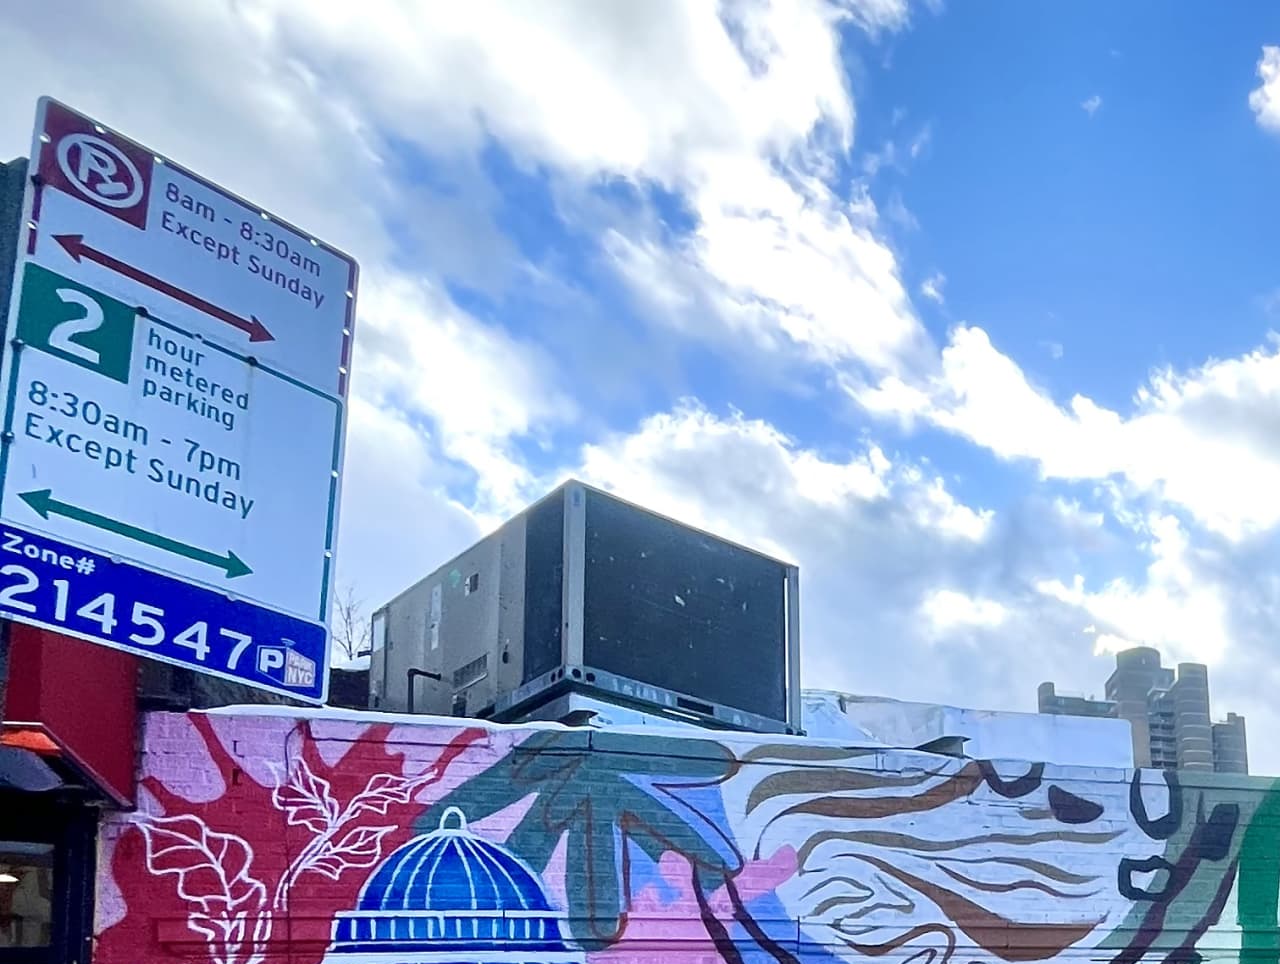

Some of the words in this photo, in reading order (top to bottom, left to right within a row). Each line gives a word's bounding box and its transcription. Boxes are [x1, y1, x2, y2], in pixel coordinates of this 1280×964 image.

[161, 211, 240, 267] Except
[247, 255, 325, 310] Sunday
[165, 182, 215, 223] 8am
[239, 220, 321, 277] 8:30am
[49, 288, 104, 364] 2
[149, 328, 205, 368] hour
[143, 379, 235, 432] parking
[146, 354, 249, 411] metered
[25, 412, 136, 474] Except
[147, 459, 255, 519] Sunday
[28, 381, 148, 446] 8:30am
[184, 438, 241, 481] 7pm
[2, 532, 96, 575] Zone#
[0, 564, 253, 671] 214547
[287, 666, 313, 685] NYC
